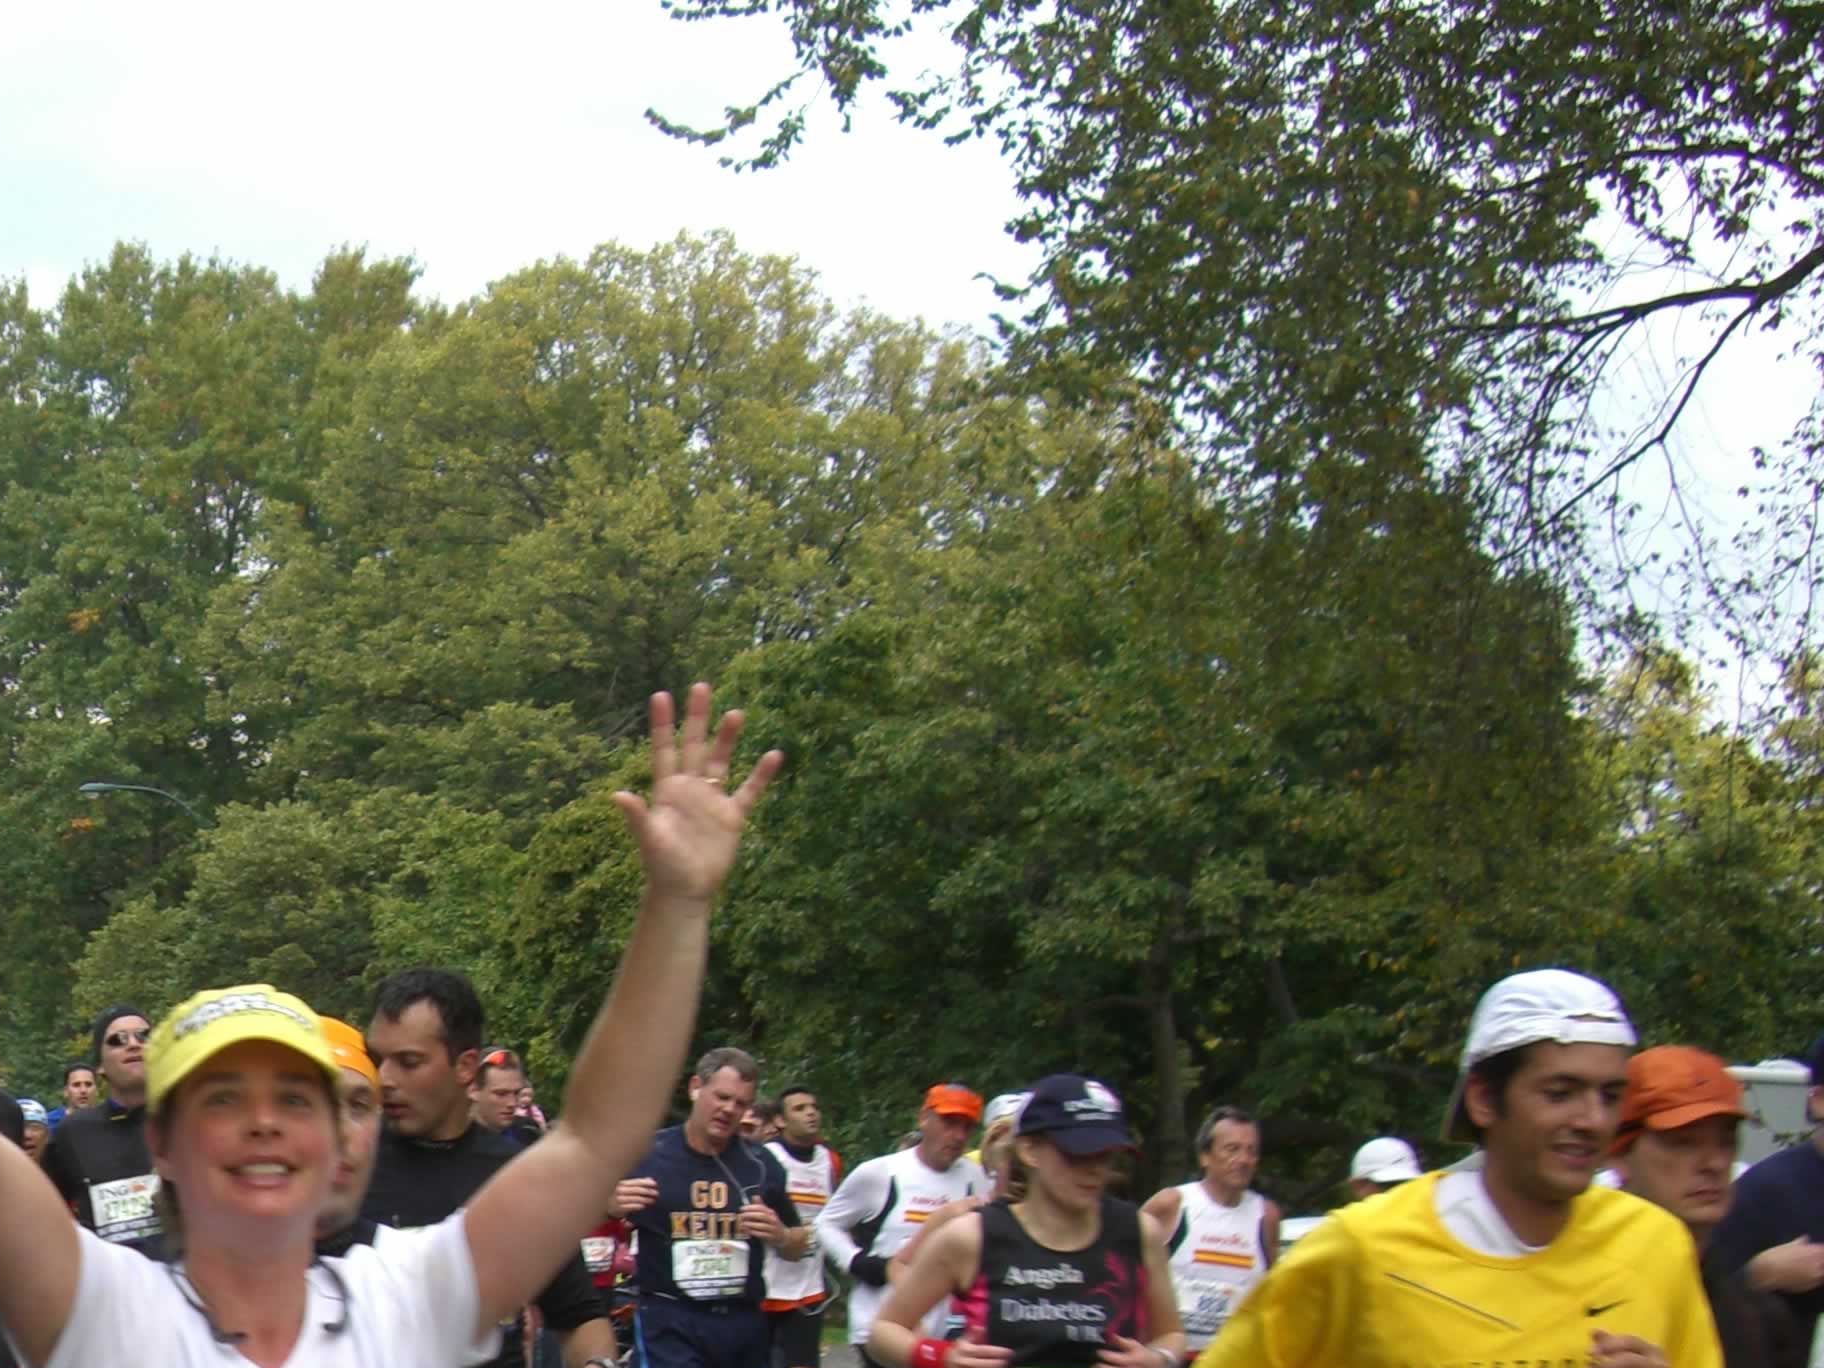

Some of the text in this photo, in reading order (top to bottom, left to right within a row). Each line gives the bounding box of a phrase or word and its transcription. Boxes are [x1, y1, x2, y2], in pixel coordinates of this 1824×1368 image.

[690, 1180, 729, 1209] GO
[1003, 1263, 1085, 1289] Angela
[999, 1298, 1107, 1322] Diabetes
